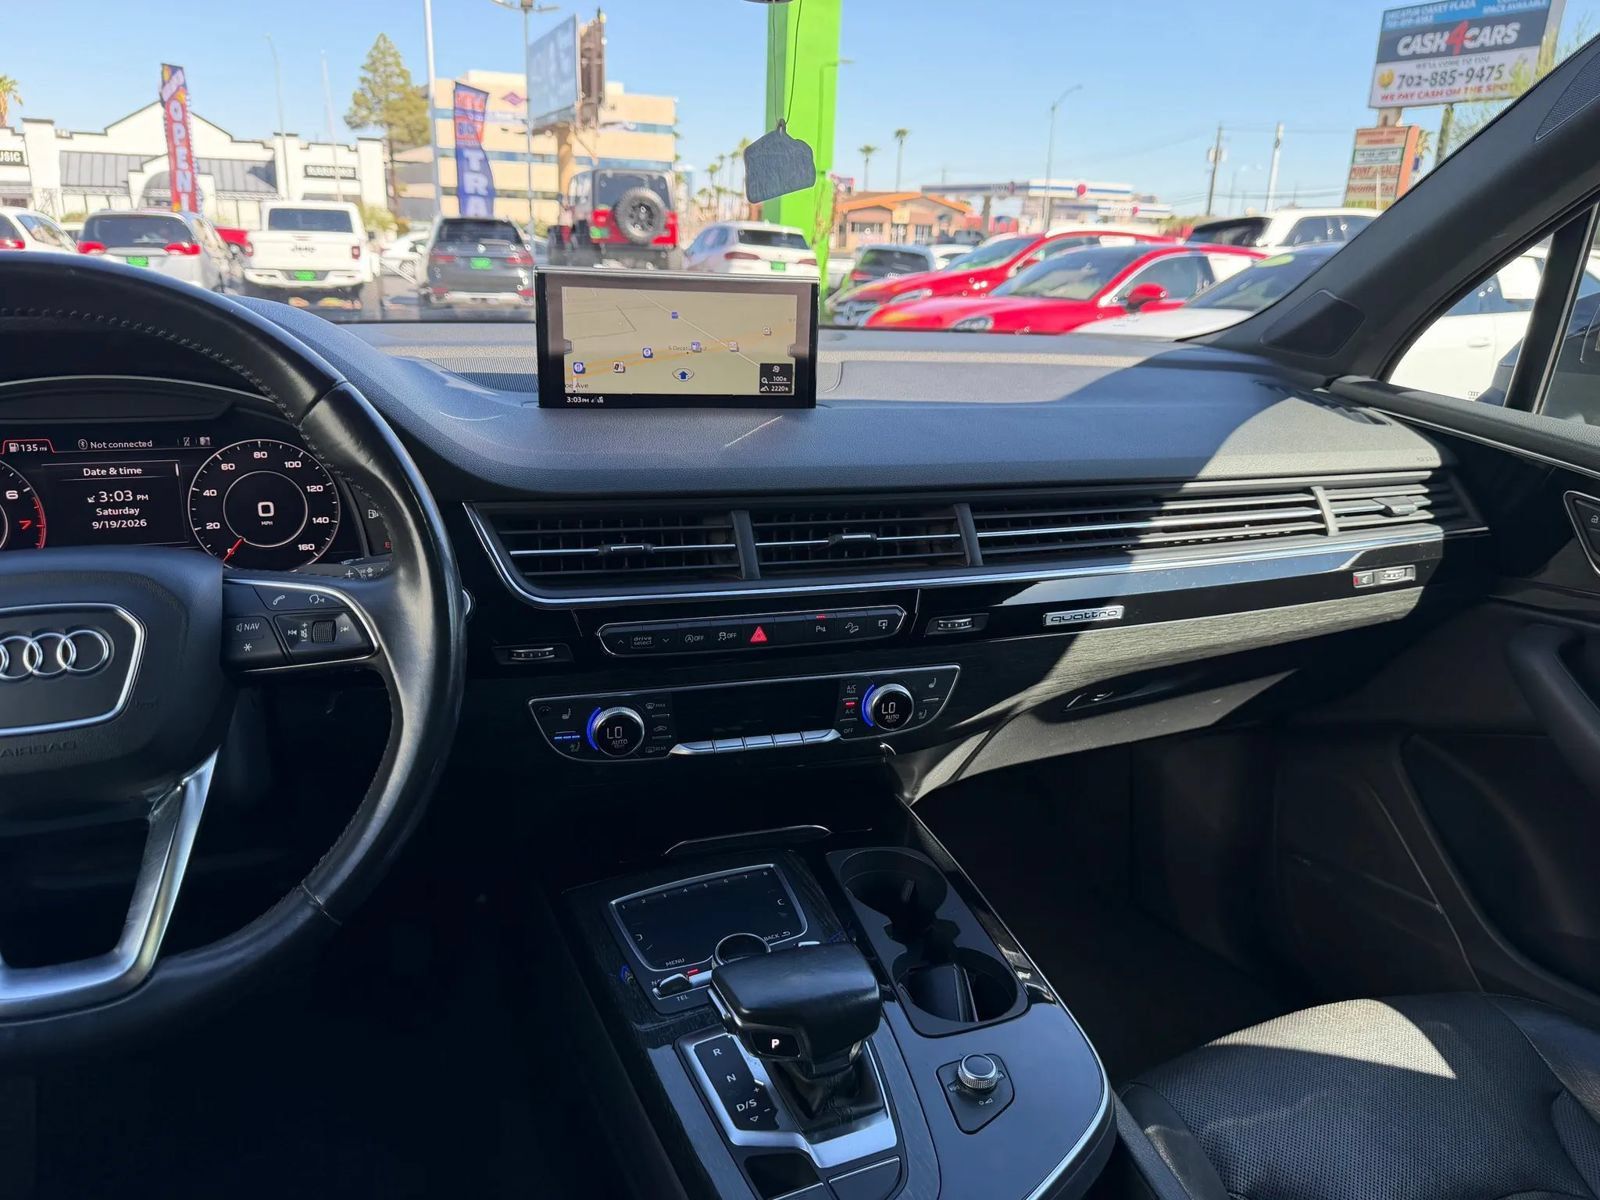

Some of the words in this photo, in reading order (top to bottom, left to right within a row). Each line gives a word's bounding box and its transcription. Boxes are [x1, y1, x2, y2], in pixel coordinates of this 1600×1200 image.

[1397, 64, 1505, 90] 702-885-9475
[1381, 93, 1394, 101] WE
[1397, 91, 1414, 100] PAY
[1417, 88, 1444, 99] CASH
[1446, 87, 1461, 96] ON
[1464, 84, 1484, 94] THE
[20, 443, 38, 452] 135
[89, 441, 107, 449] Not
[108, 440, 153, 449] connected
[253, 451, 268, 459] 80
[83, 468, 107, 477] Date
[108, 467, 118, 476] &
[119, 466, 142, 476] time
[221, 463, 235, 471] 60
[5, 490, 19, 500] 6
[98, 490, 133, 503] 3:03
[203, 489, 217, 497] 40
[95, 507, 140, 516] Saturday
[257, 501, 275, 517] 0
[18, 519, 32, 530] 7
[92, 518, 147, 529] 9/19/2026
[312, 516, 329, 524] 140
[205, 522, 221, 530] 20
[297, 543, 315, 551] 160
[1051, 610, 1118, 623] quattro
[244, 623, 260, 631] NAV
[881, 702, 896, 714] LO
[606, 726, 623, 740] LO
[665, 957, 685, 966] MENU
[771, 1038, 780, 1049] P
[712, 1048, 722, 1056] R
[726, 1073, 737, 1082] N
[736, 1098, 757, 1112] D/S
